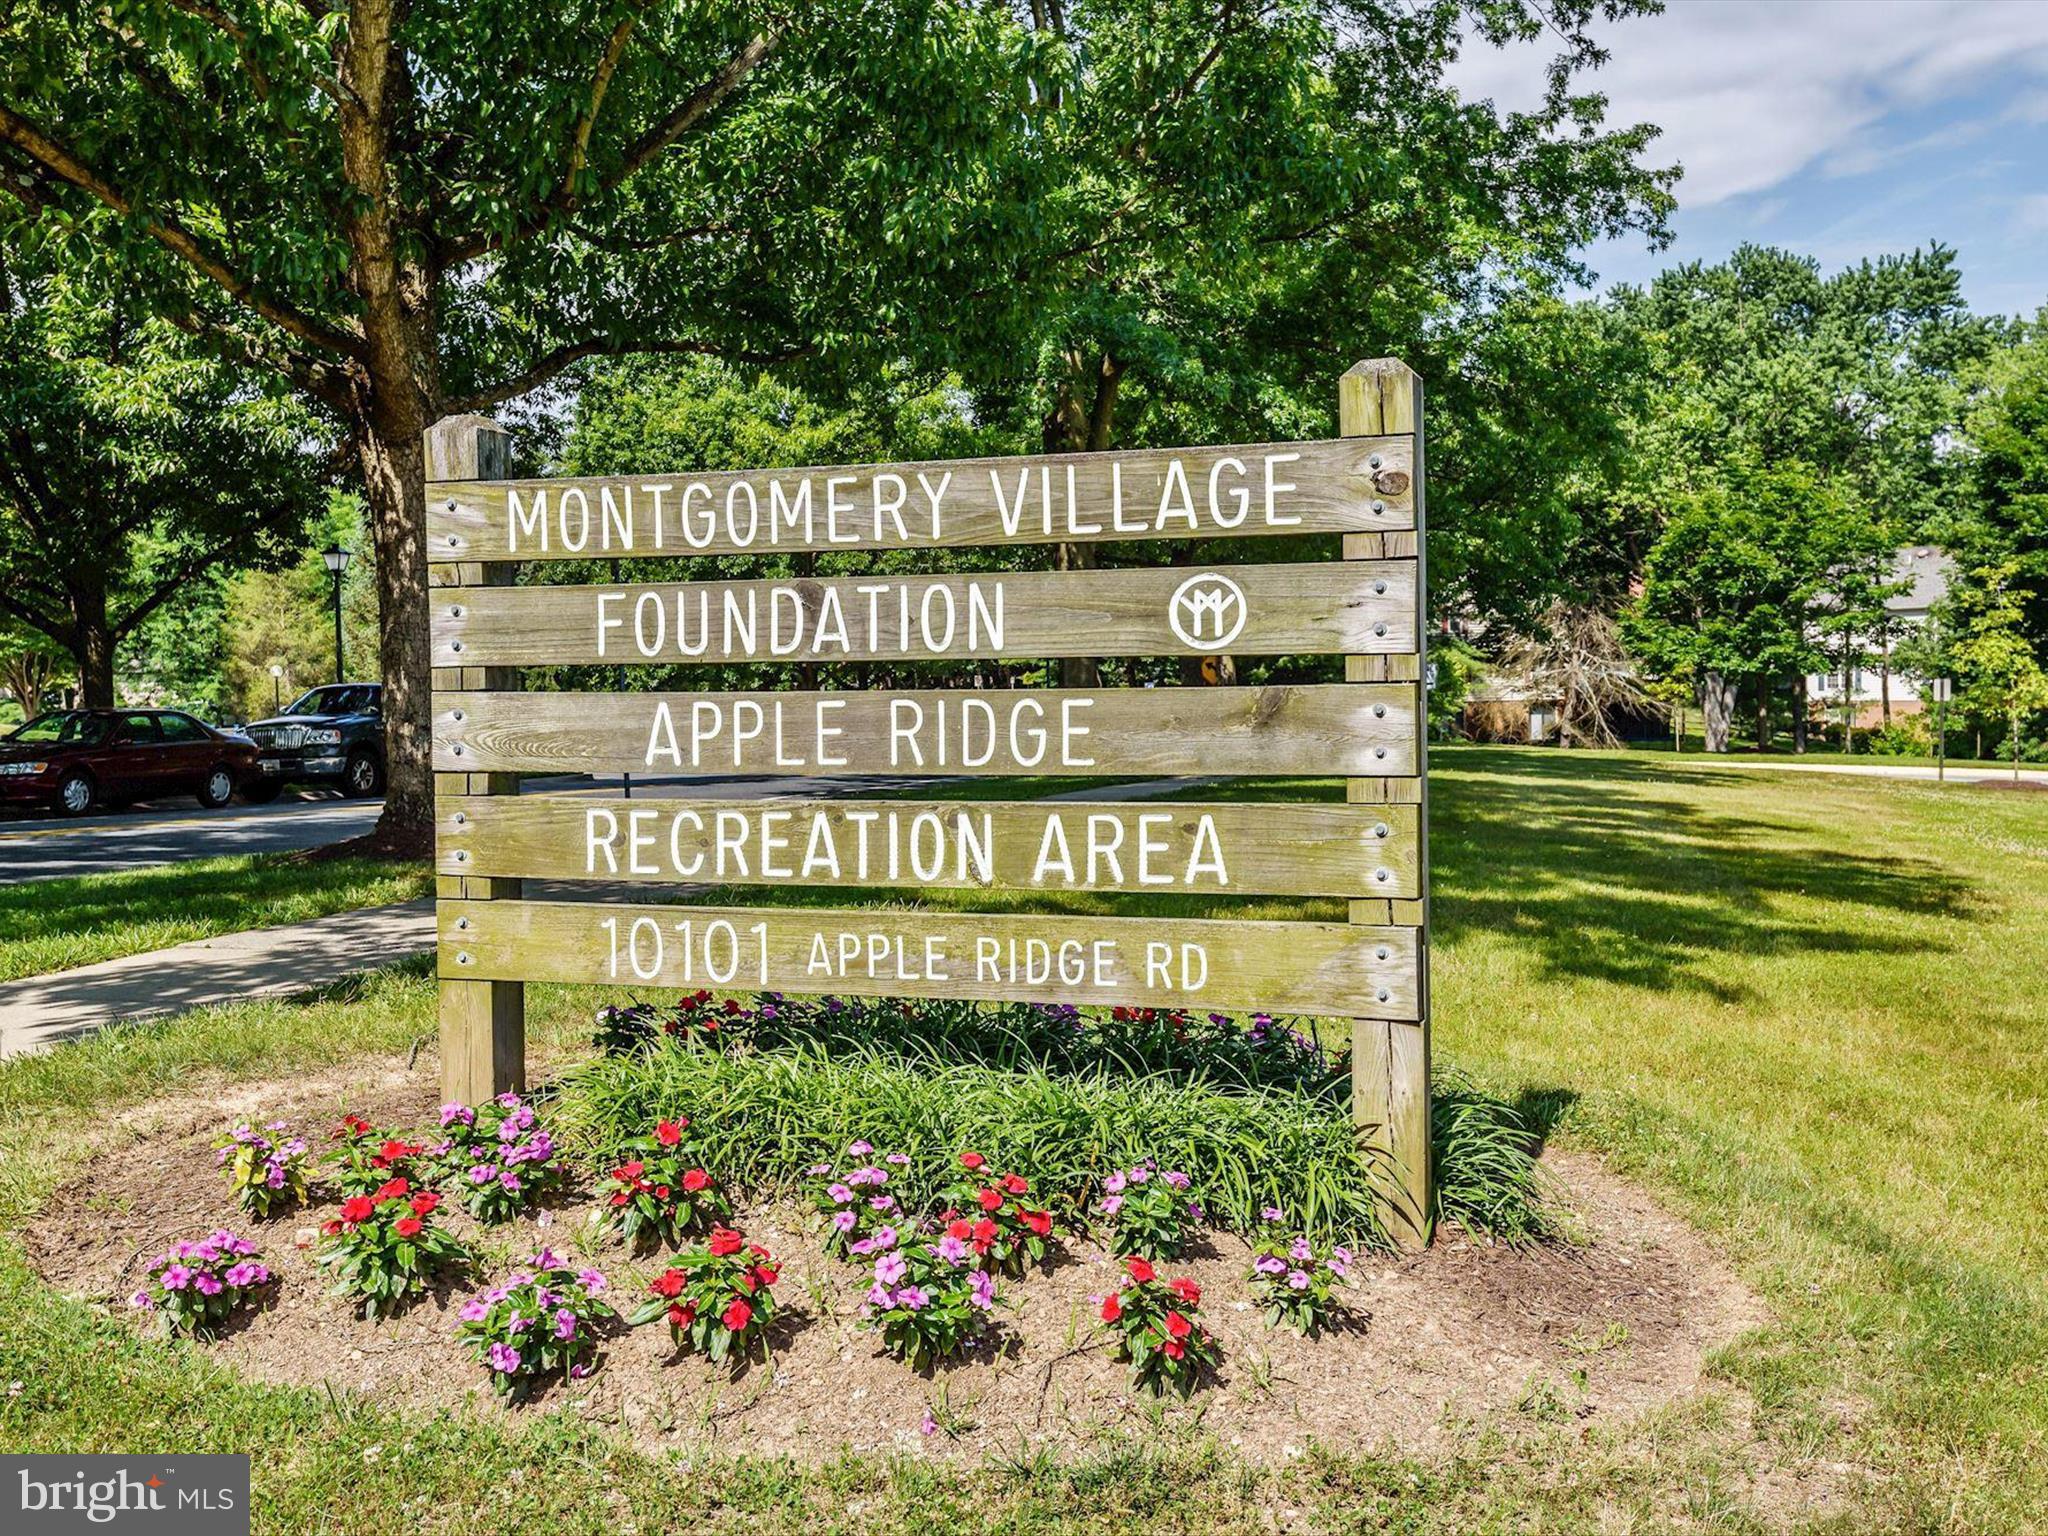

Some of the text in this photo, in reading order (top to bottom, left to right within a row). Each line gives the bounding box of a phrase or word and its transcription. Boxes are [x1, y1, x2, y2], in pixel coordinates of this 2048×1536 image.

[505, 452, 1302, 553] MONTGOMERY VILLAGE
[596, 582, 1005, 658] FOUNDATION
[644, 697, 1095, 768] APPLE RIDGE
[585, 807, 1230, 887] RECREATION AREA
[600, 916, 1209, 992] 10101 APPLE RIDGE RD
